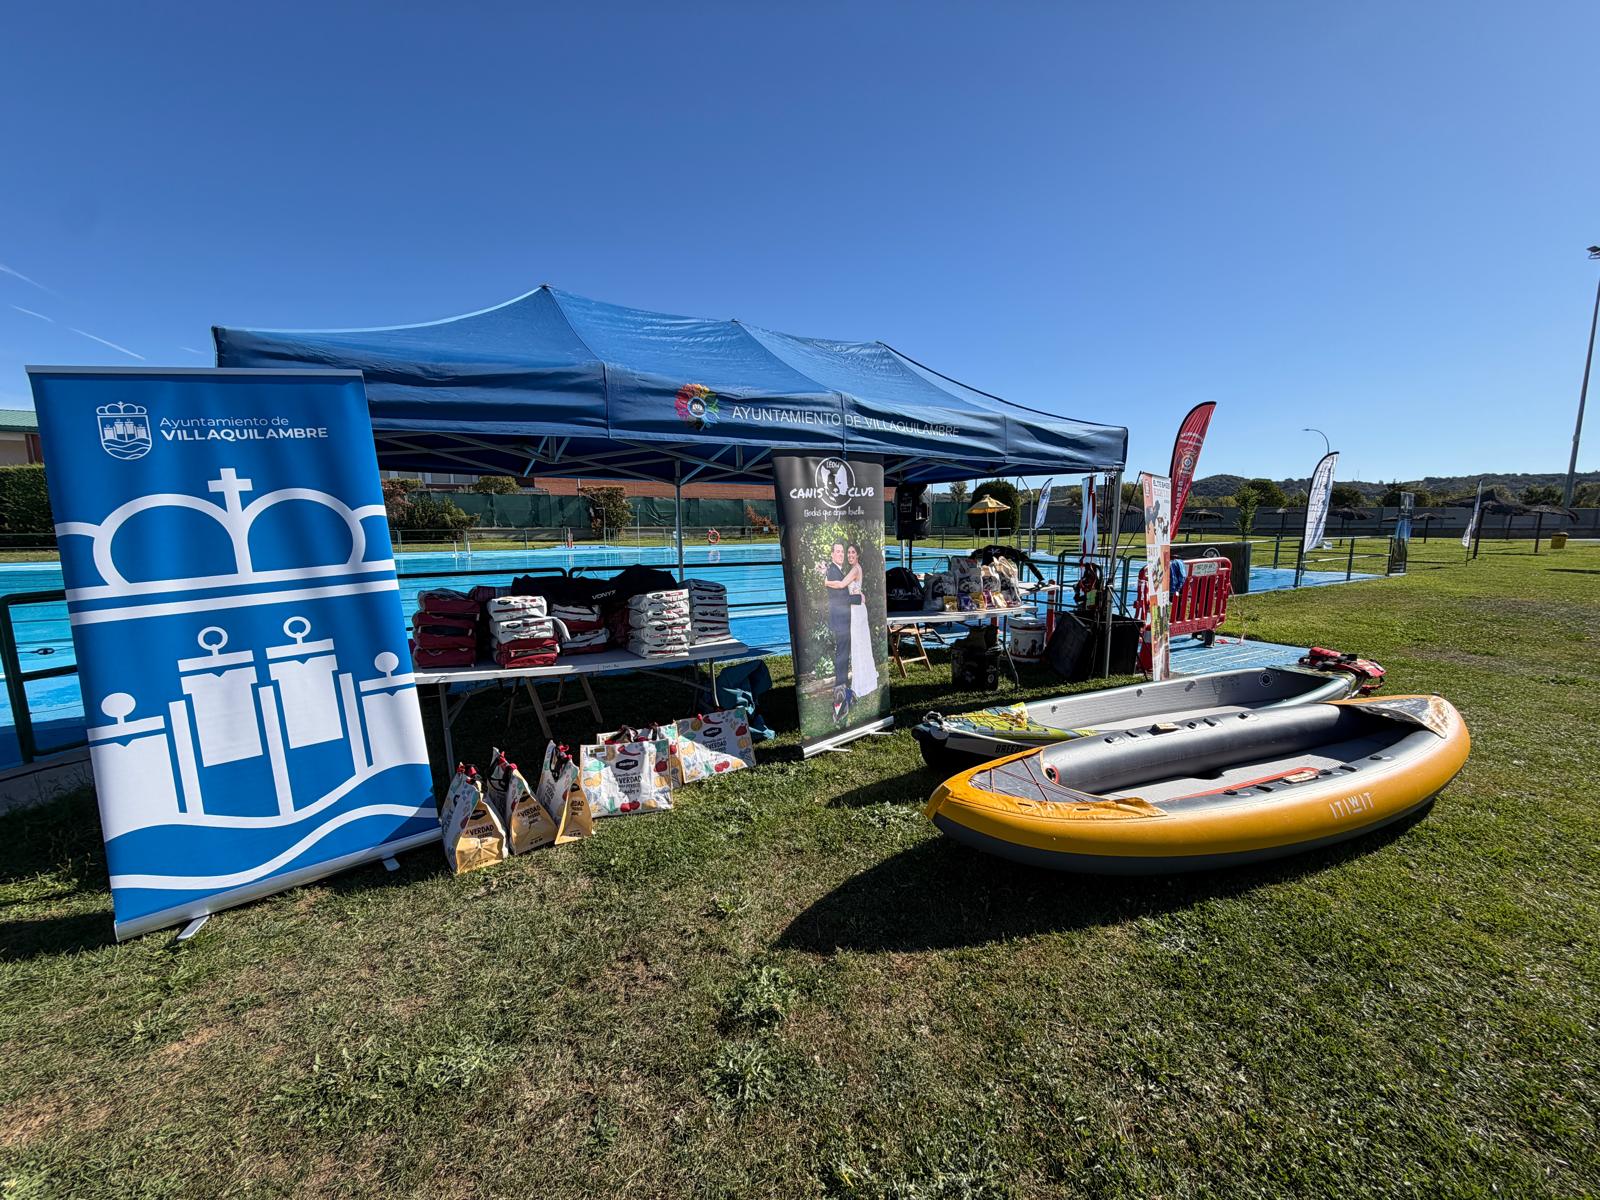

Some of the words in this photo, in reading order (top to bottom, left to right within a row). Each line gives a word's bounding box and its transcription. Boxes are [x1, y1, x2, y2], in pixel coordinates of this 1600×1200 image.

[159, 416, 268, 430] Ayuntamiento
[271, 416, 289, 426] de
[732, 406, 842, 426] AYUNTAMIENTO
[844, 414, 863, 428] DE
[864, 416, 960, 438] VILLAQUILAMBRE
[160, 427, 329, 442] VILLAQUILAMBRE
[789, 487, 825, 499] CANIS
[847, 486, 875, 498] CLUB
[1328, 791, 1375, 819] ITIWIT
[469, 824, 495, 836] VERDAD
